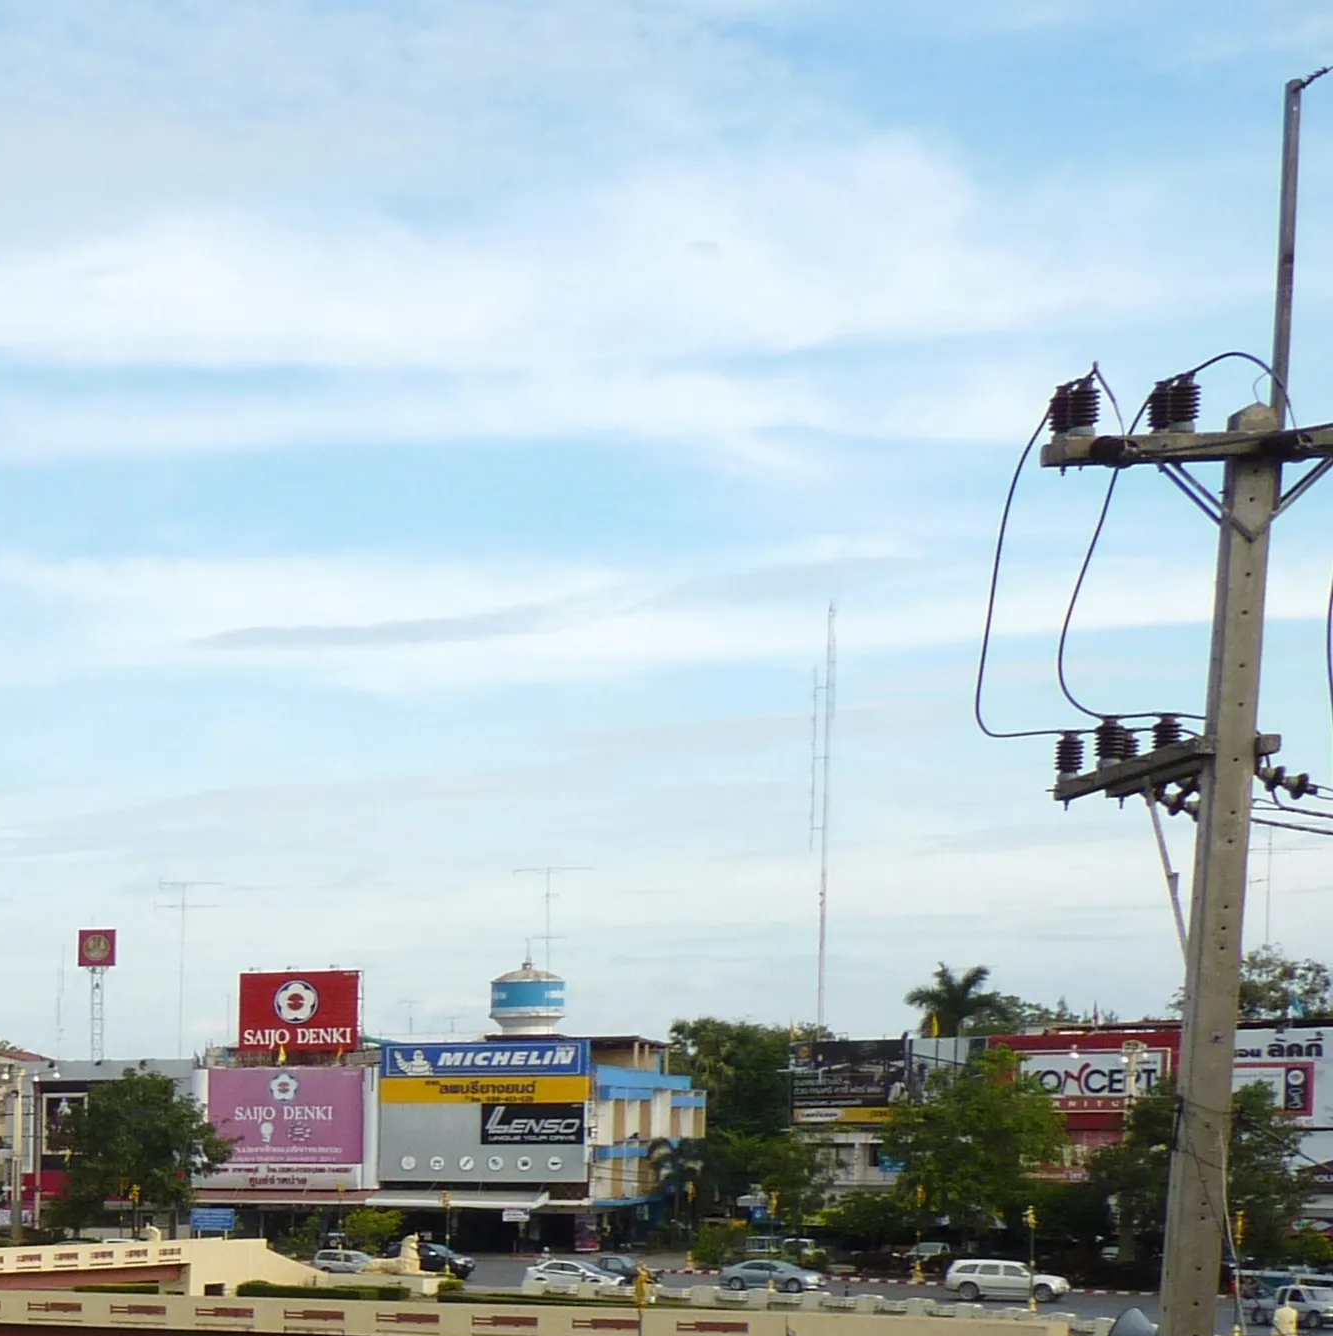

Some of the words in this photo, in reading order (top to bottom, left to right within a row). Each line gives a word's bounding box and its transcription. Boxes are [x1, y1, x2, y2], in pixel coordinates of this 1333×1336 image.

[244, 1029, 290, 1049] SAIJO
[296, 1027, 352, 1044] DENKI
[437, 1048, 576, 1066] MICHELIN
[235, 1106, 276, 1124] SAIJO
[283, 1106, 333, 1120] DENKI
[485, 1106, 580, 1134] LENSO
